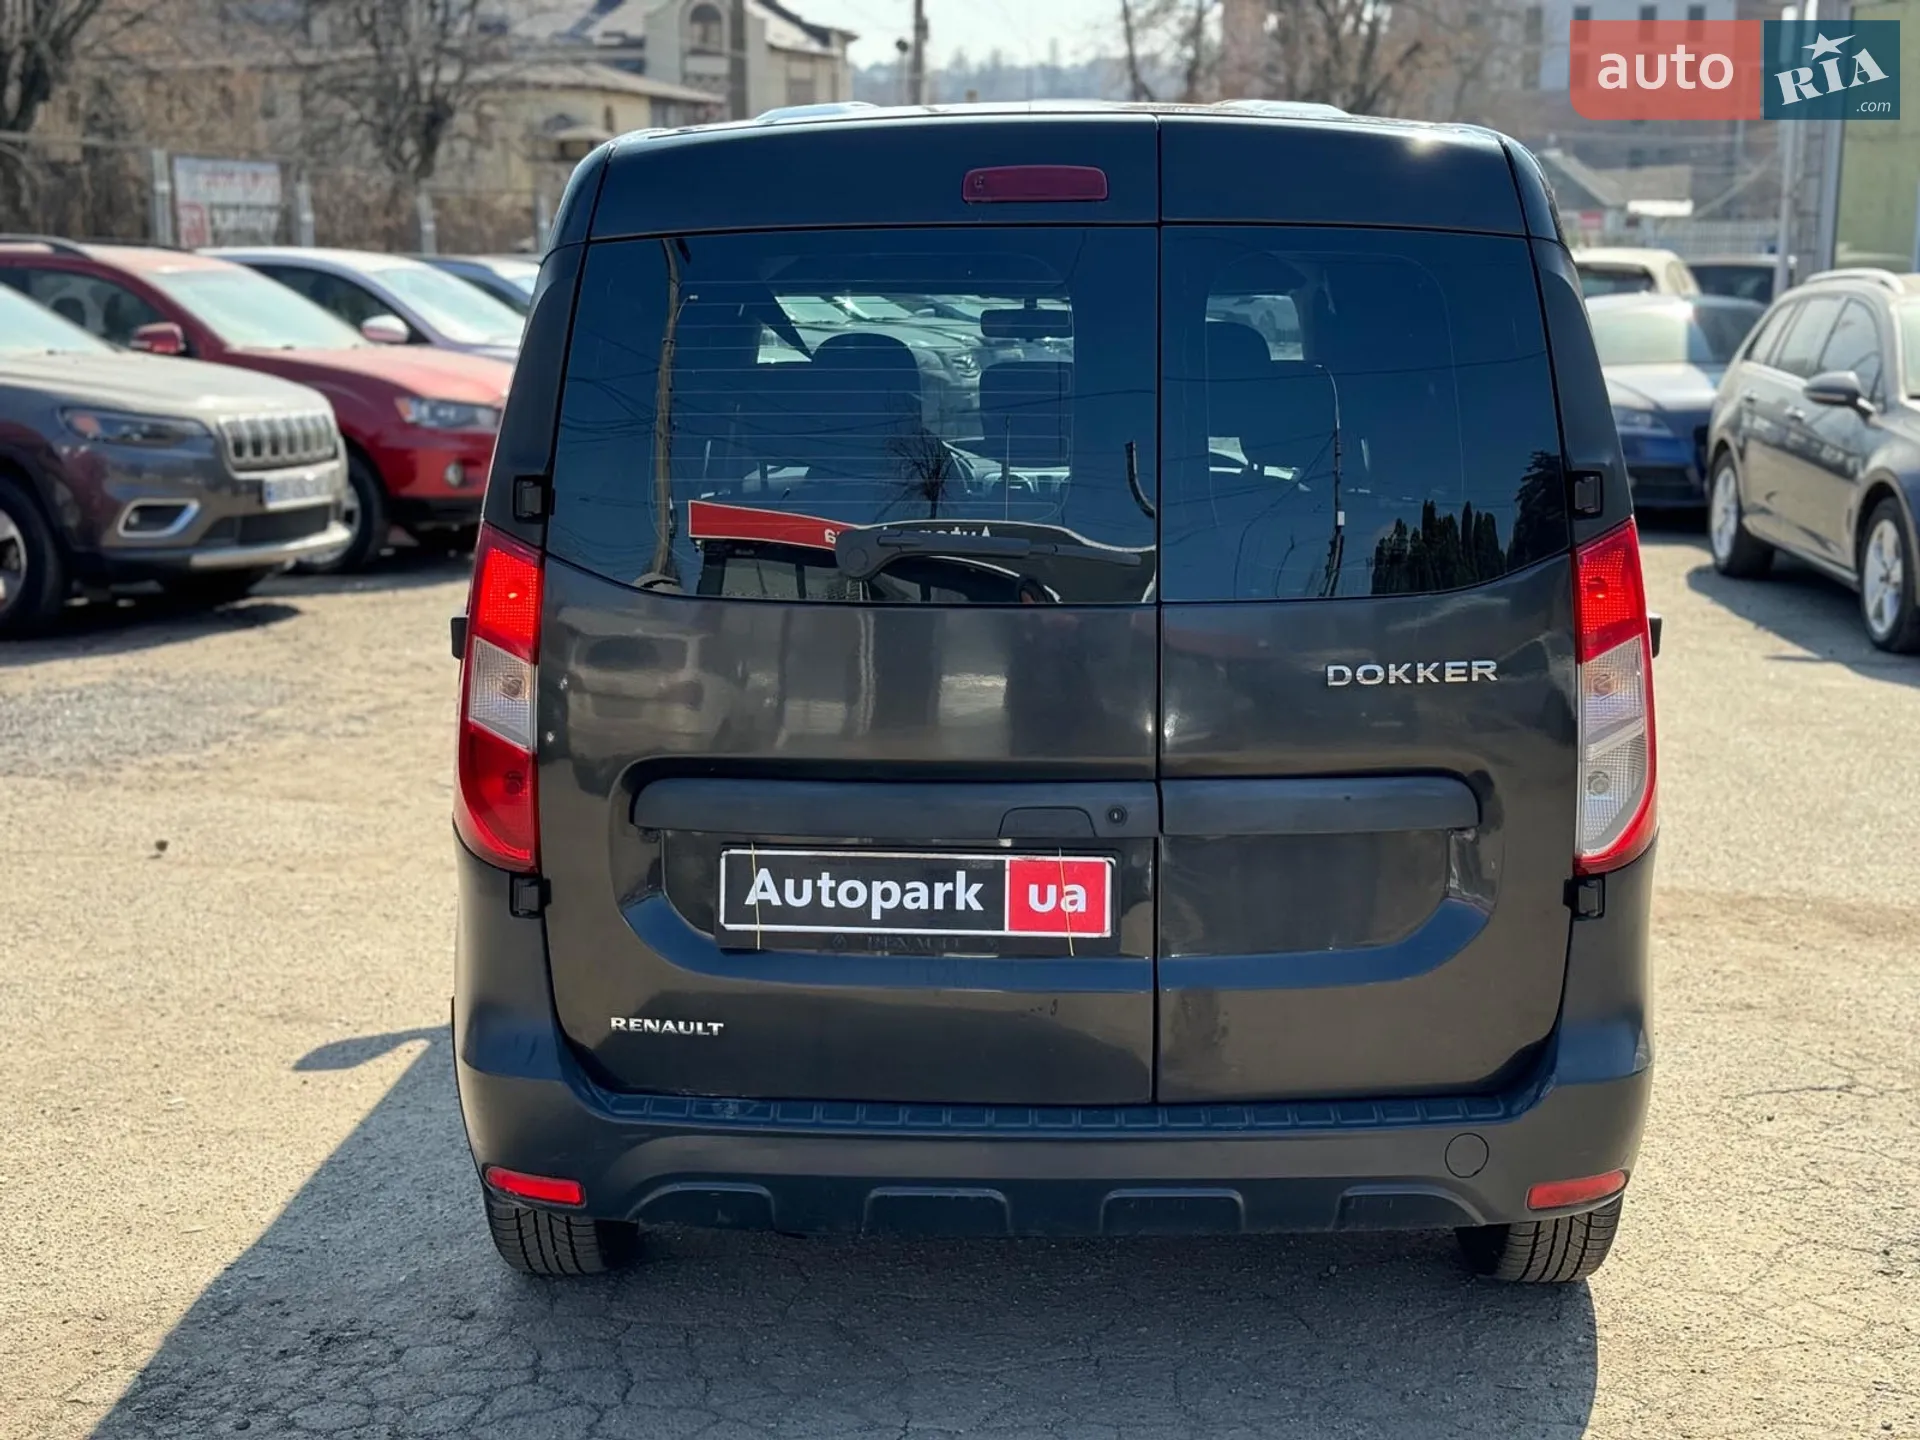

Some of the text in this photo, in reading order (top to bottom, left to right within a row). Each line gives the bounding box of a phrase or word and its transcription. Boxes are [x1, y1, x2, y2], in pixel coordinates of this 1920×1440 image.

[1327, 660, 1498, 687] DOKKER
[744, 867, 1087, 920] Autopark ua
[610, 1017, 725, 1036] RENAULT
